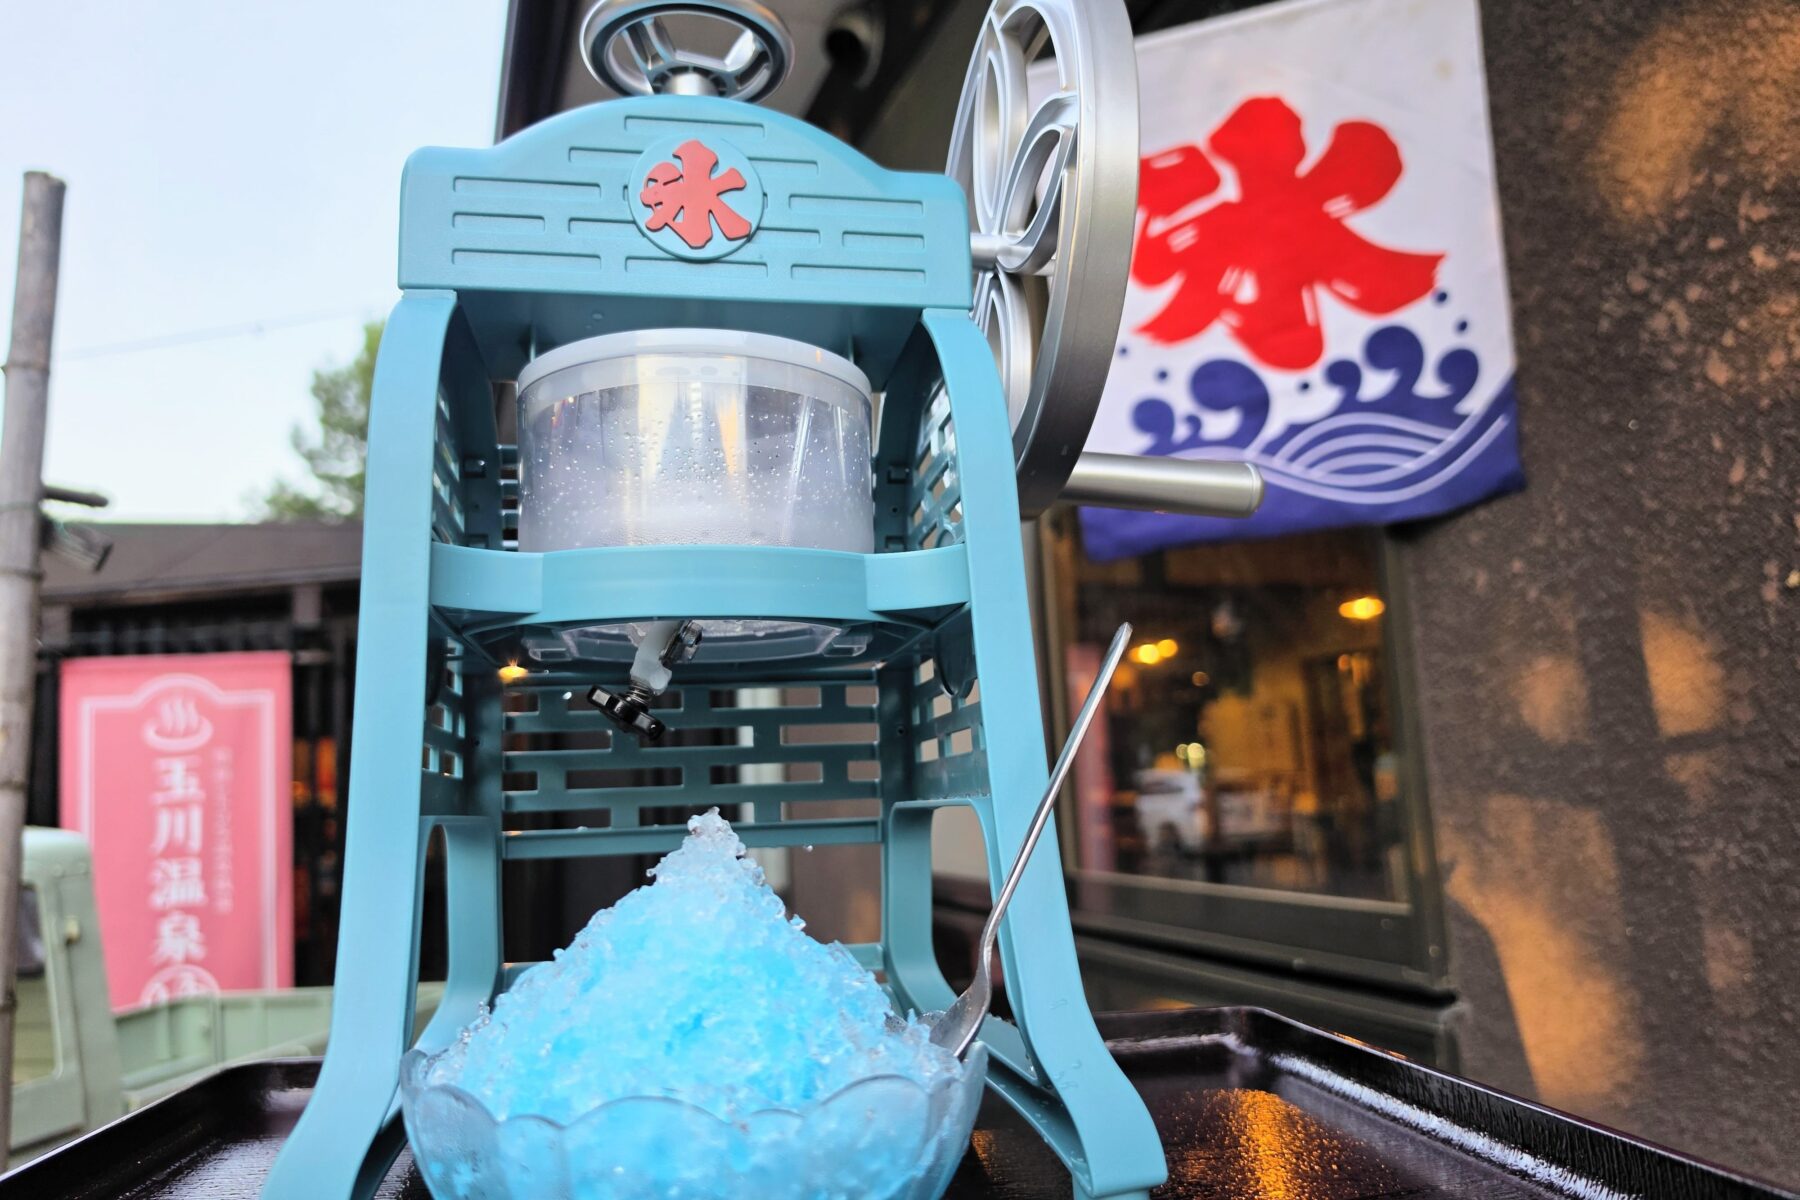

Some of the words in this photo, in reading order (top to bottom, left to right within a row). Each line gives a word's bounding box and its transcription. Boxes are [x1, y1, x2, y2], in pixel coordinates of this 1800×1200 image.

[641, 139, 752, 249] 氷
[1131, 96, 1446, 372] 氷
[151, 755, 207, 964] 玉川温泉
